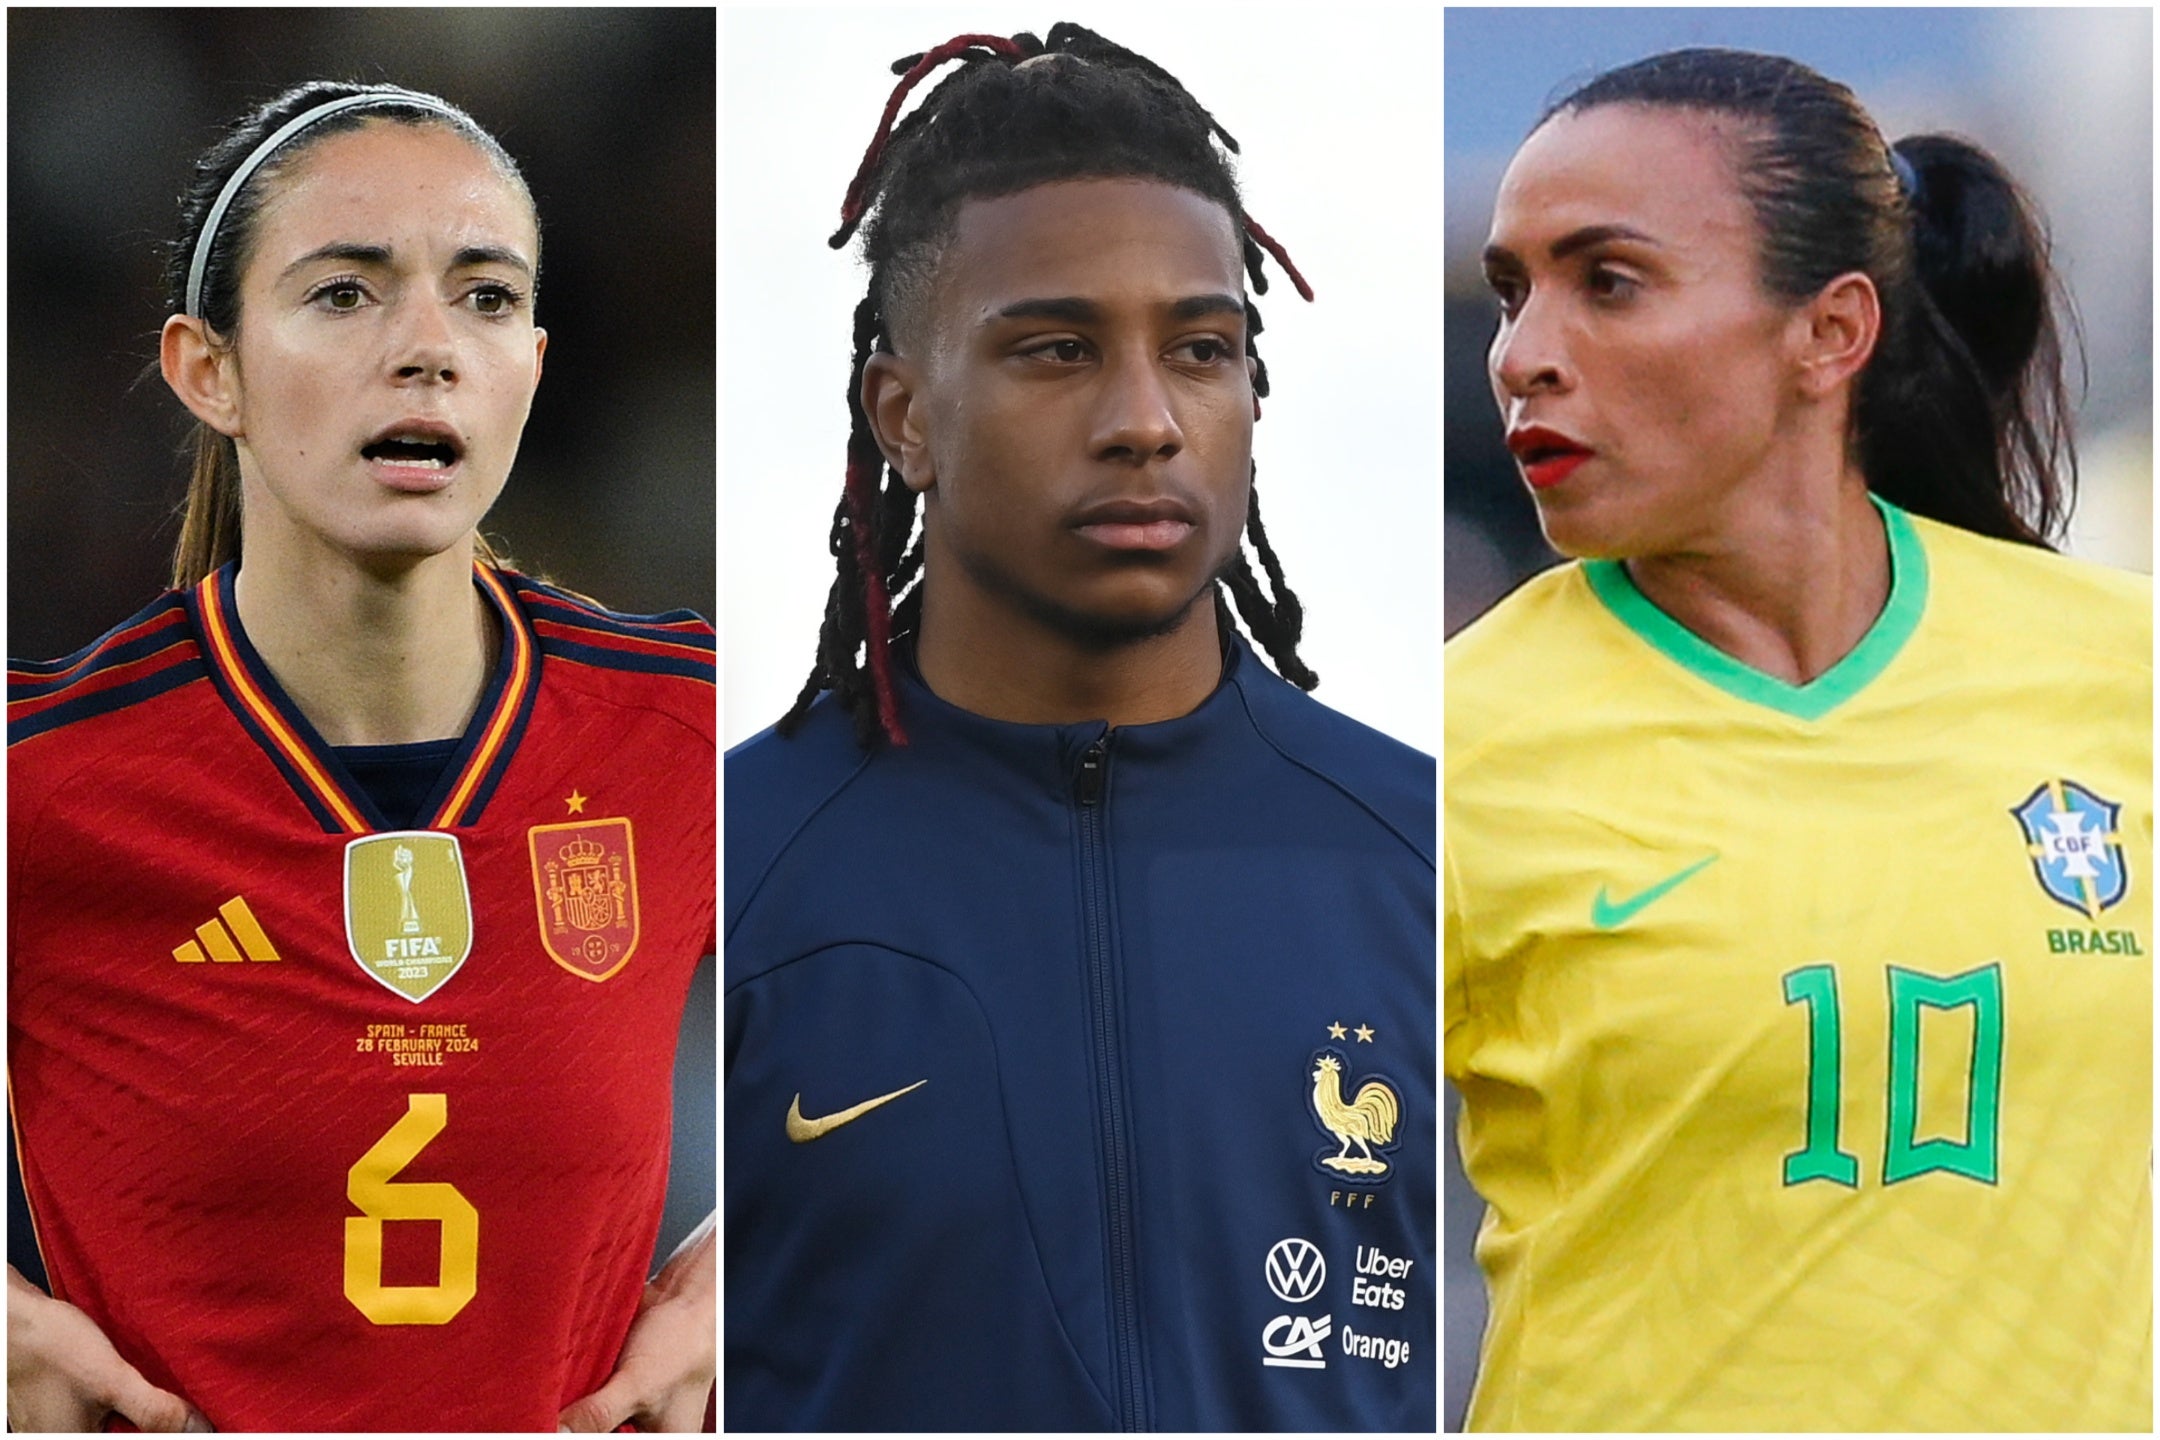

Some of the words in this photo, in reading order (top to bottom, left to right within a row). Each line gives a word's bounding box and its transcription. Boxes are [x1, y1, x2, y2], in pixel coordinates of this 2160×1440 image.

[385, 937, 440, 958] FIFA
[2046, 928, 2144, 956] BRASIL
[398, 966, 429, 979] 2023
[356, 1038, 374, 1052] 28
[378, 1038, 441, 1052] FEBRUARY
[445, 1038, 479, 1052] 2024
[367, 1024, 405, 1038] SPAIN
[420, 1024, 467, 1038] FRANCE
[393, 1052, 443, 1066] SEVILLE
[1782, 962, 2004, 1189] 10
[344, 1093, 479, 1325] 6
[1355, 1245, 1413, 1279] Uber
[1352, 1277, 1405, 1311] Eats
[1342, 1324, 1410, 1369] Orange
